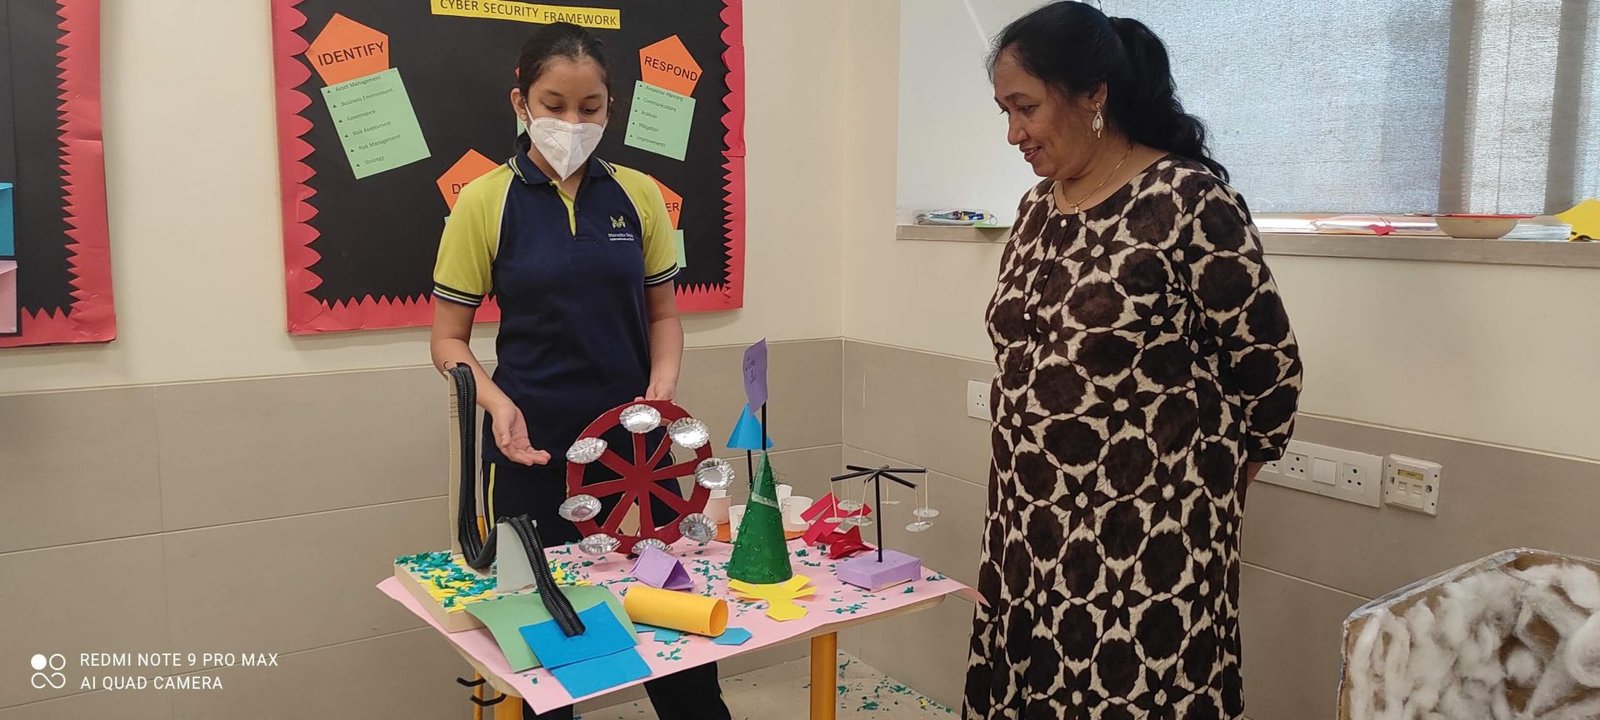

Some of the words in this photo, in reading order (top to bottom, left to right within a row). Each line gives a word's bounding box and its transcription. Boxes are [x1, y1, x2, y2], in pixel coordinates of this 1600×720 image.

[440, 0, 479, 12] CYBER
[483, 3, 539, 18] SECURITY
[544, 11, 617, 26] FRAMEWORK
[317, 41, 385, 67] IDENTIFY
[644, 55, 698, 81] RESPOND
[349, 76, 382, 88] Management
[340, 97, 362, 107] Business
[346, 109, 376, 121] Governance
[353, 129, 363, 137] Risk
[359, 143, 369, 151] Risk
[369, 134, 401, 147] Management
